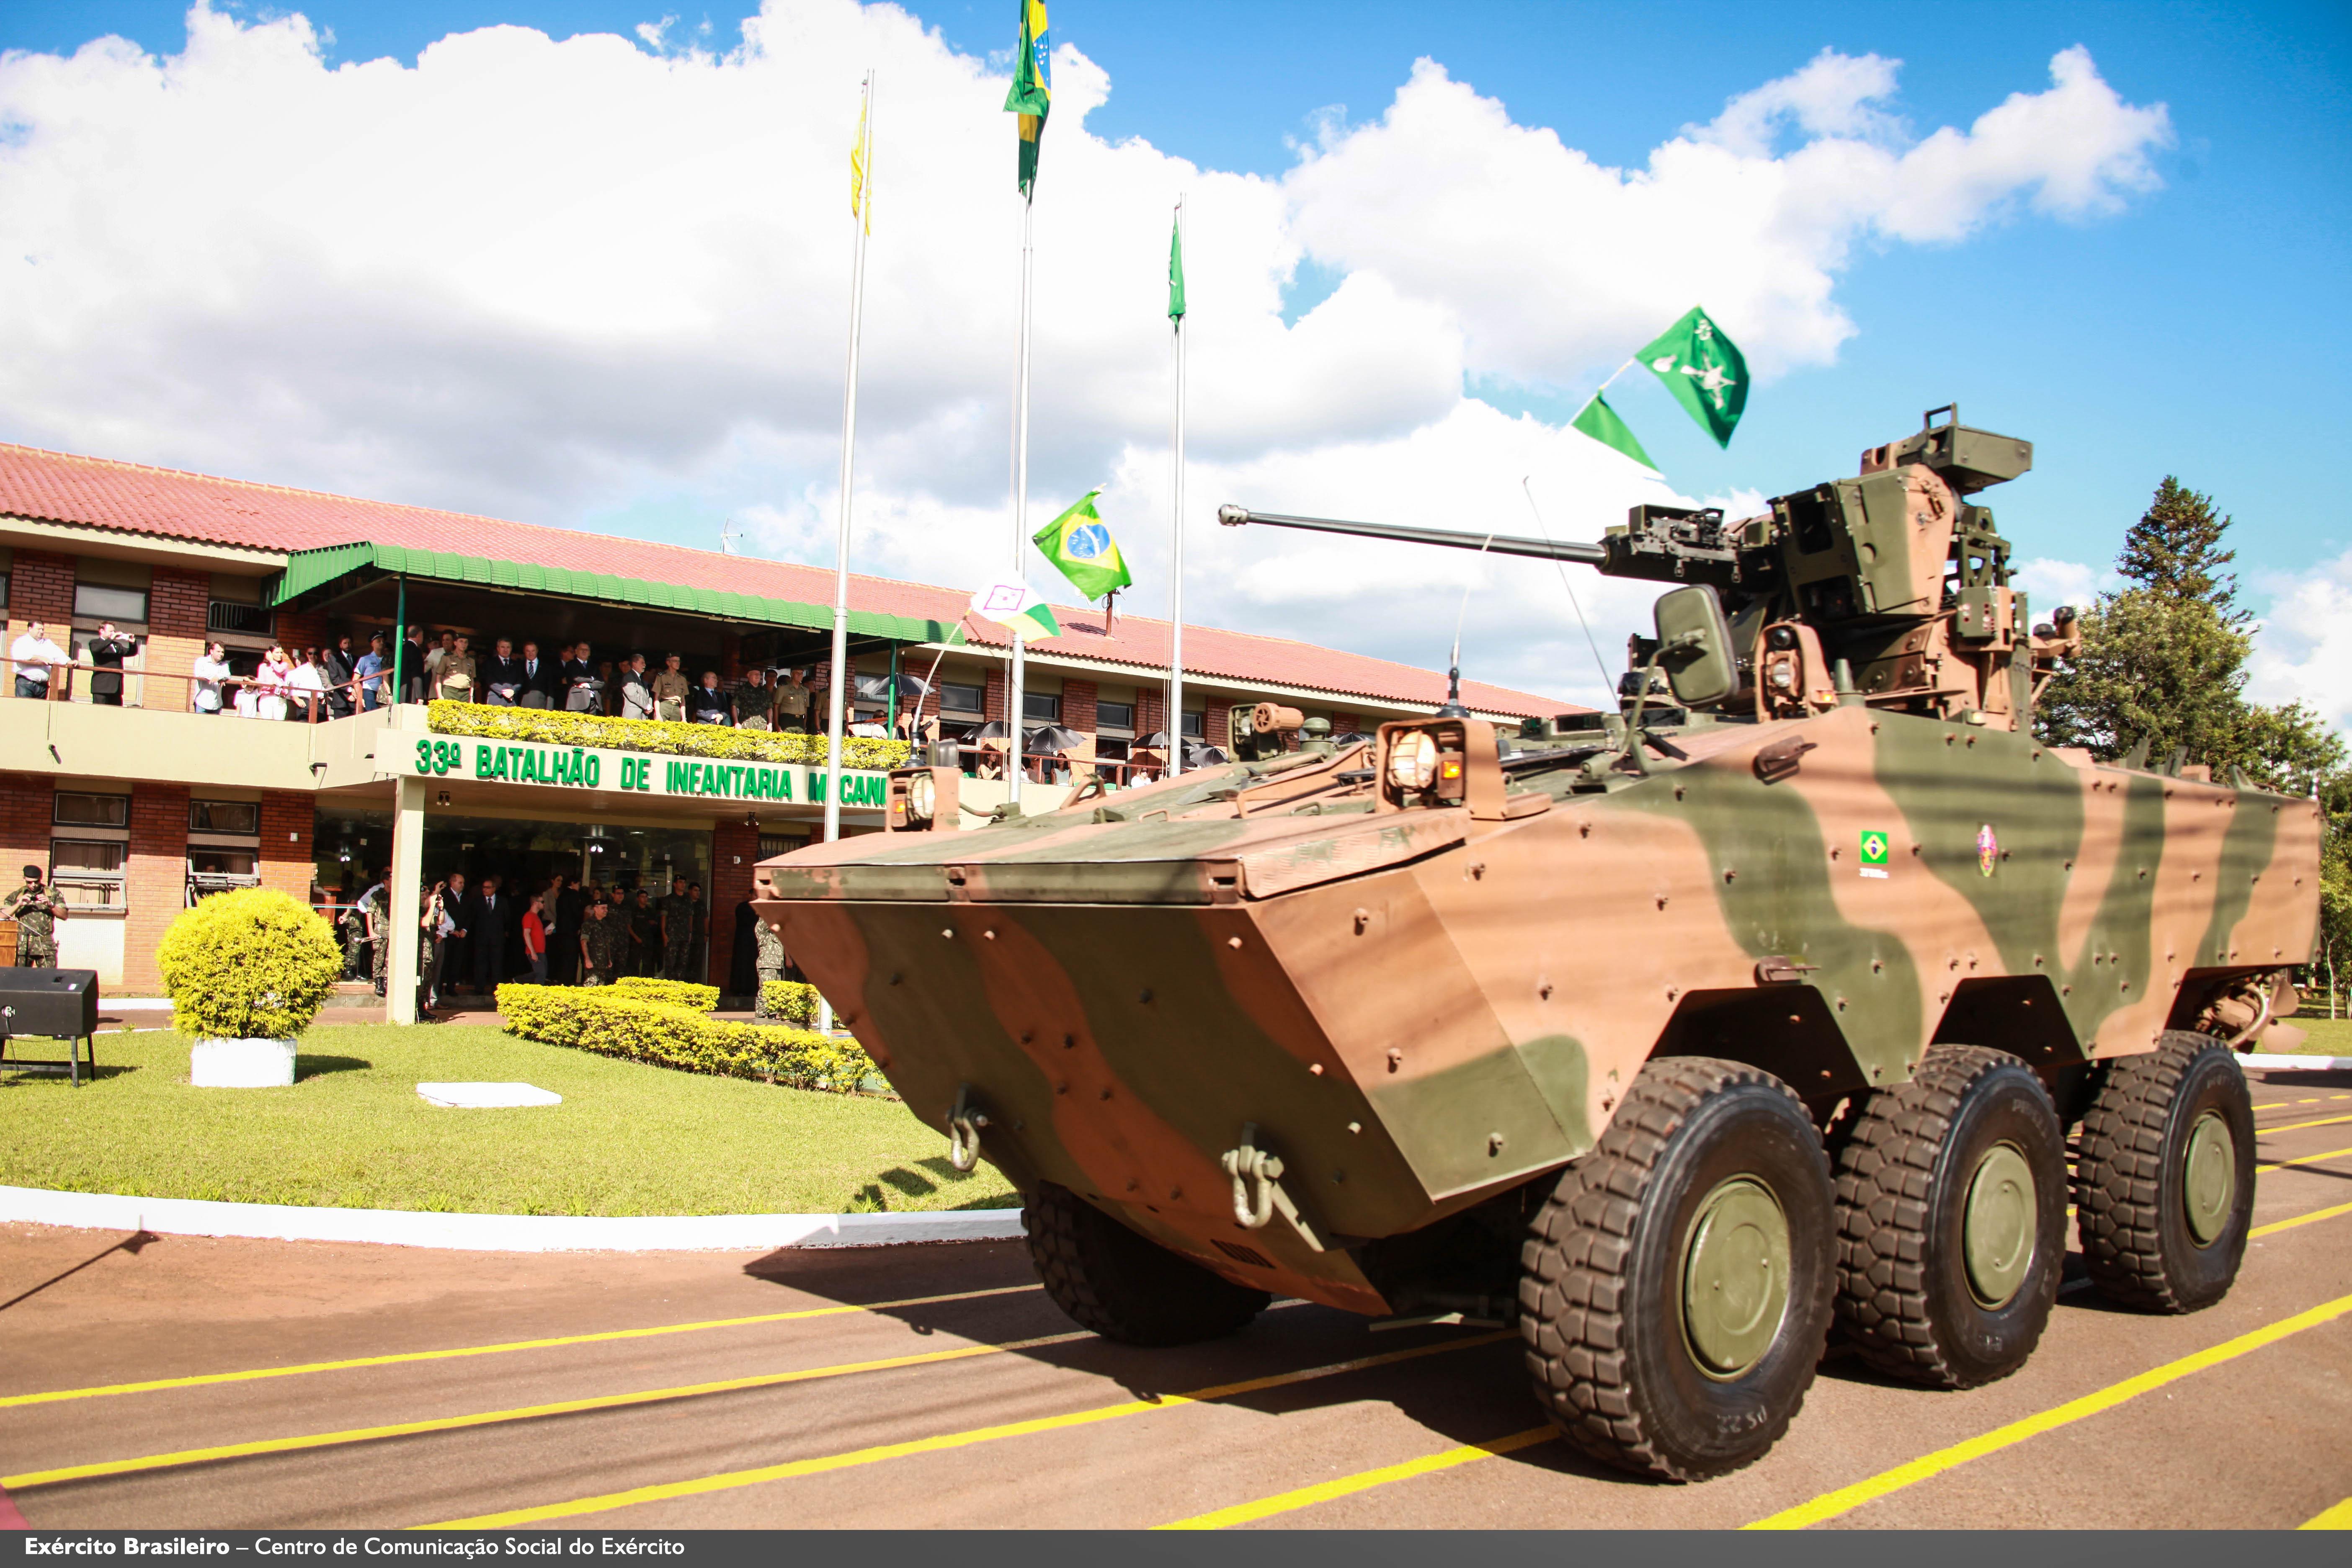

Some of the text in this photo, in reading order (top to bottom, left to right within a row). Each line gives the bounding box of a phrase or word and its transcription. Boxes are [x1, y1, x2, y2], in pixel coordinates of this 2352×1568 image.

[476, 745, 600, 785] BATALHÃO
[620, 757, 651, 789] DE
[666, 761, 793, 799] INFANTARIA
[808, 773, 887, 805] MCANI
